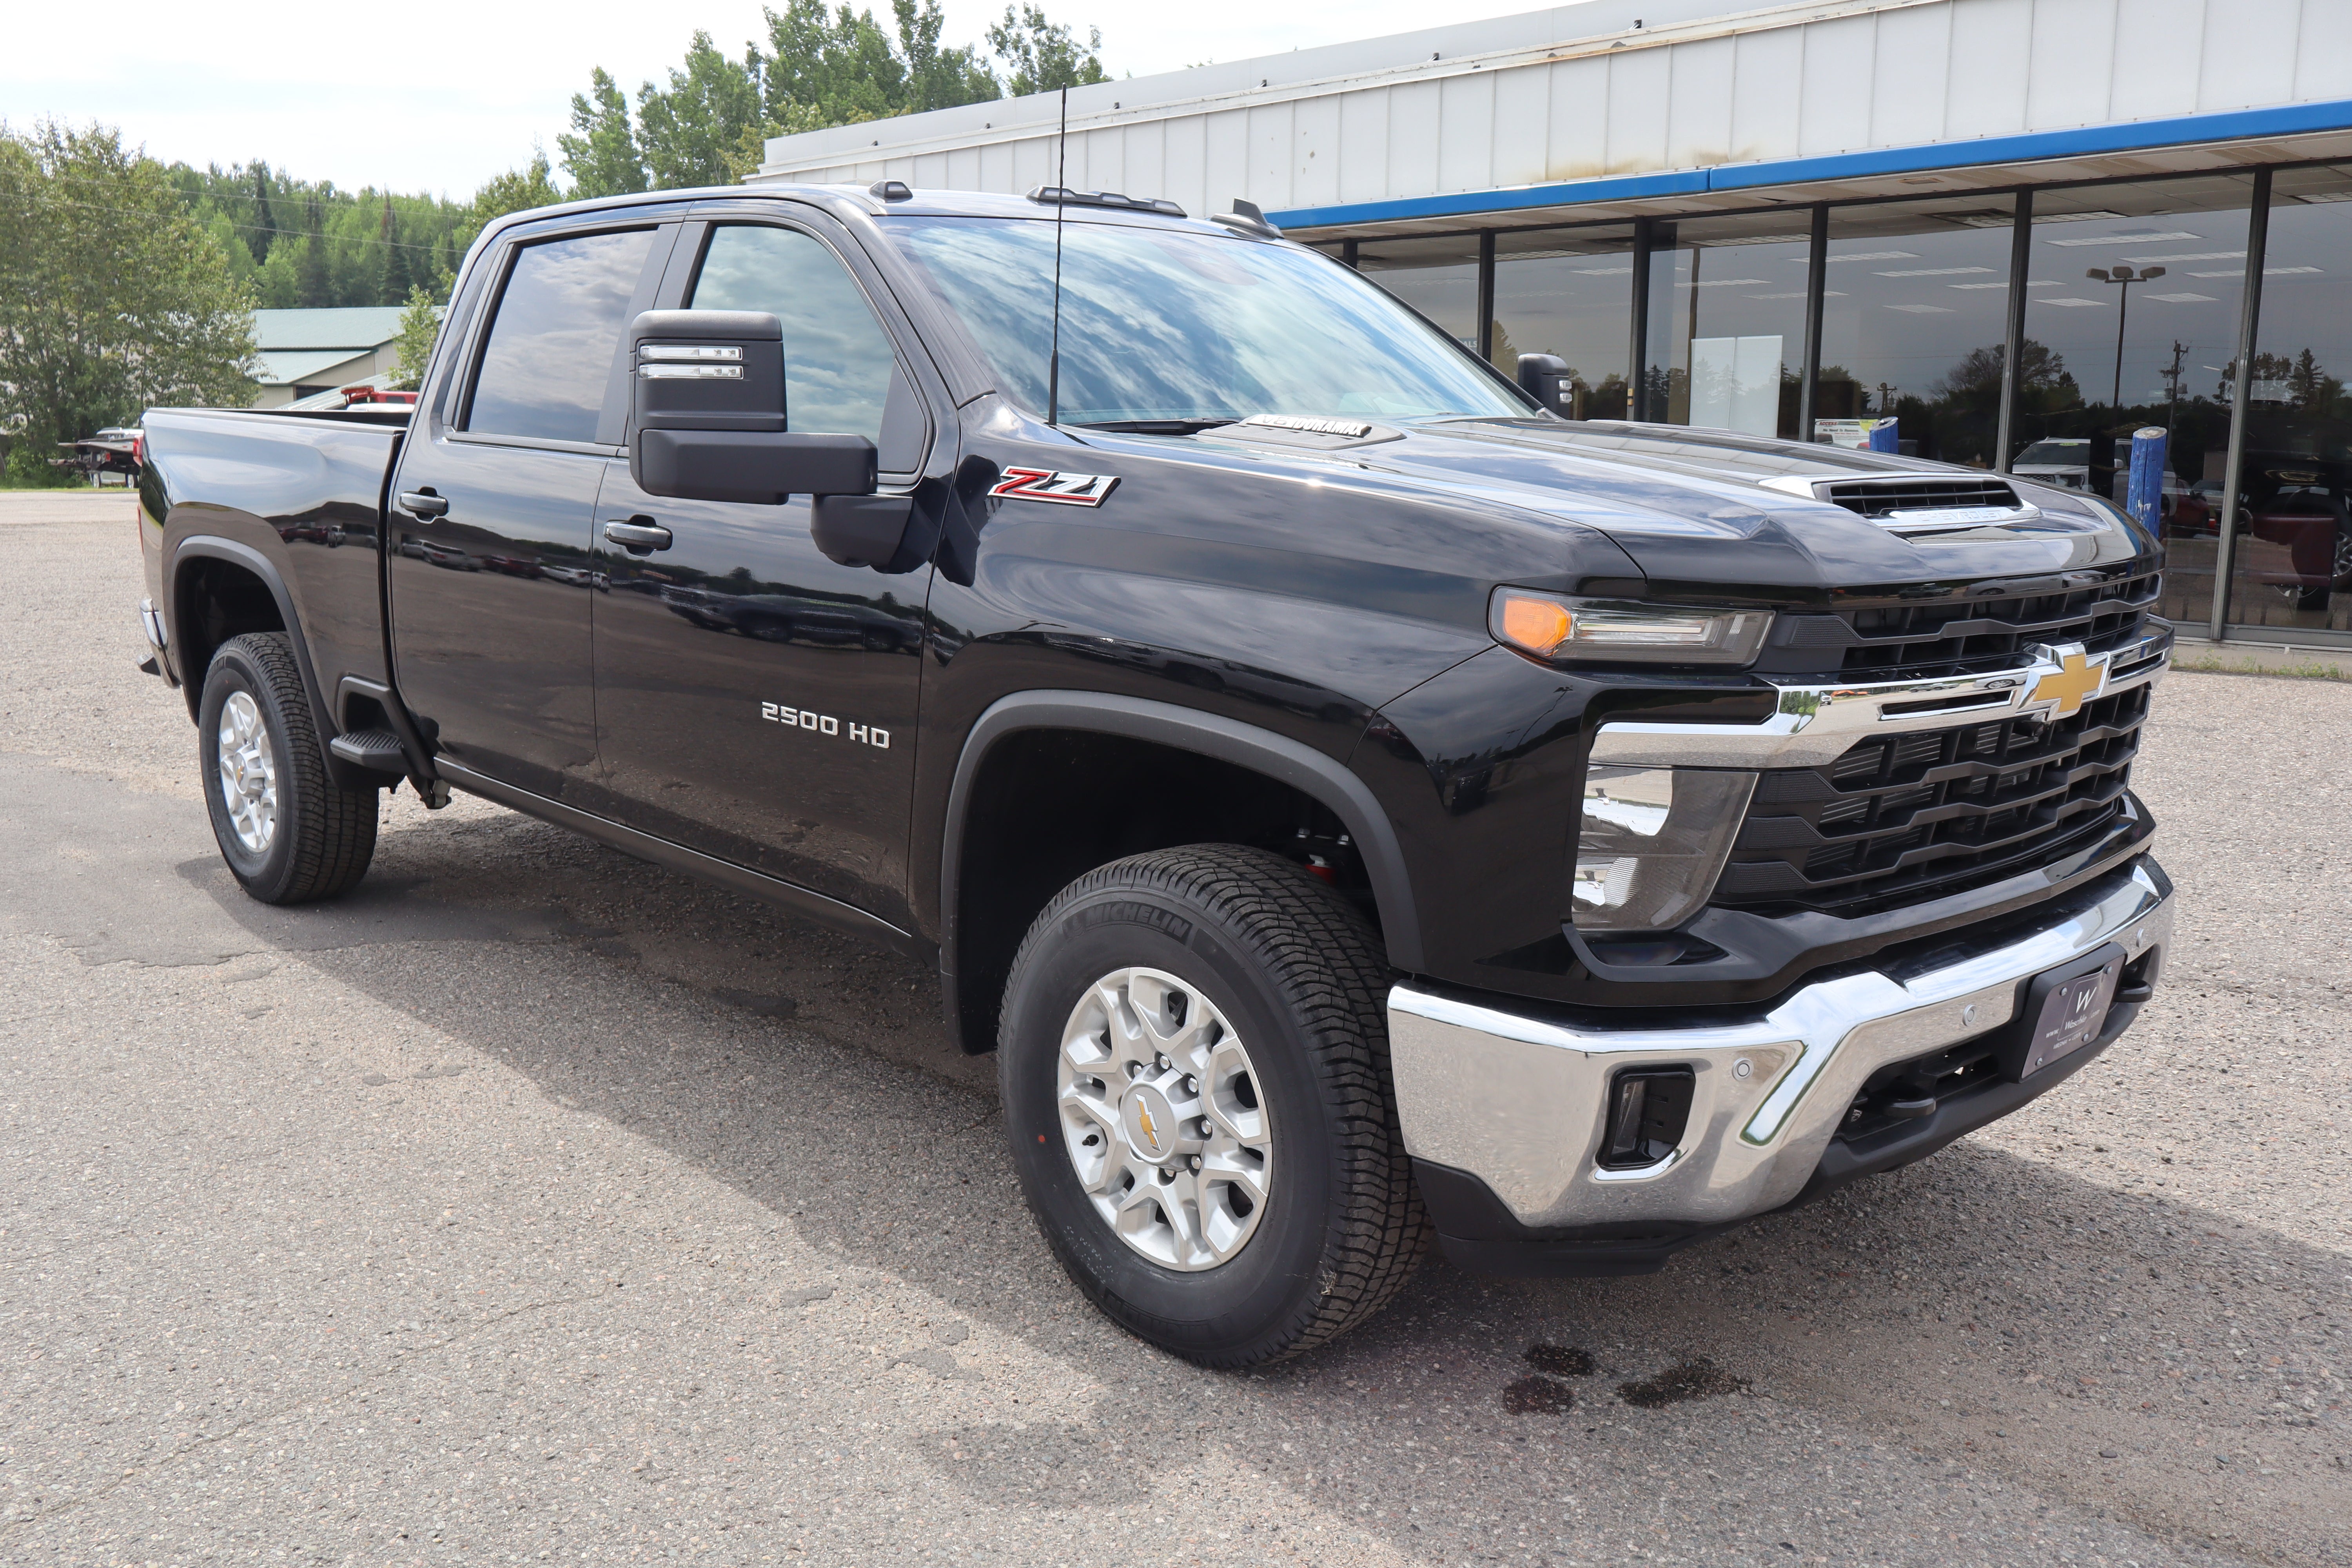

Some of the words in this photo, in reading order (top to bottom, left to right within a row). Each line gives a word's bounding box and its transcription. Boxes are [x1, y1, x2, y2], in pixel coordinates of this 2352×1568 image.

[1294, 417, 1368, 436] DURAMAX
[987, 465, 1121, 508] Z71
[1917, 510, 2002, 521] CHEVROLET
[762, 701, 840, 736] 2500
[849, 722, 891, 749] HD
[1085, 902, 1189, 938] MICHELIN
[2076, 986, 2097, 1014] W
